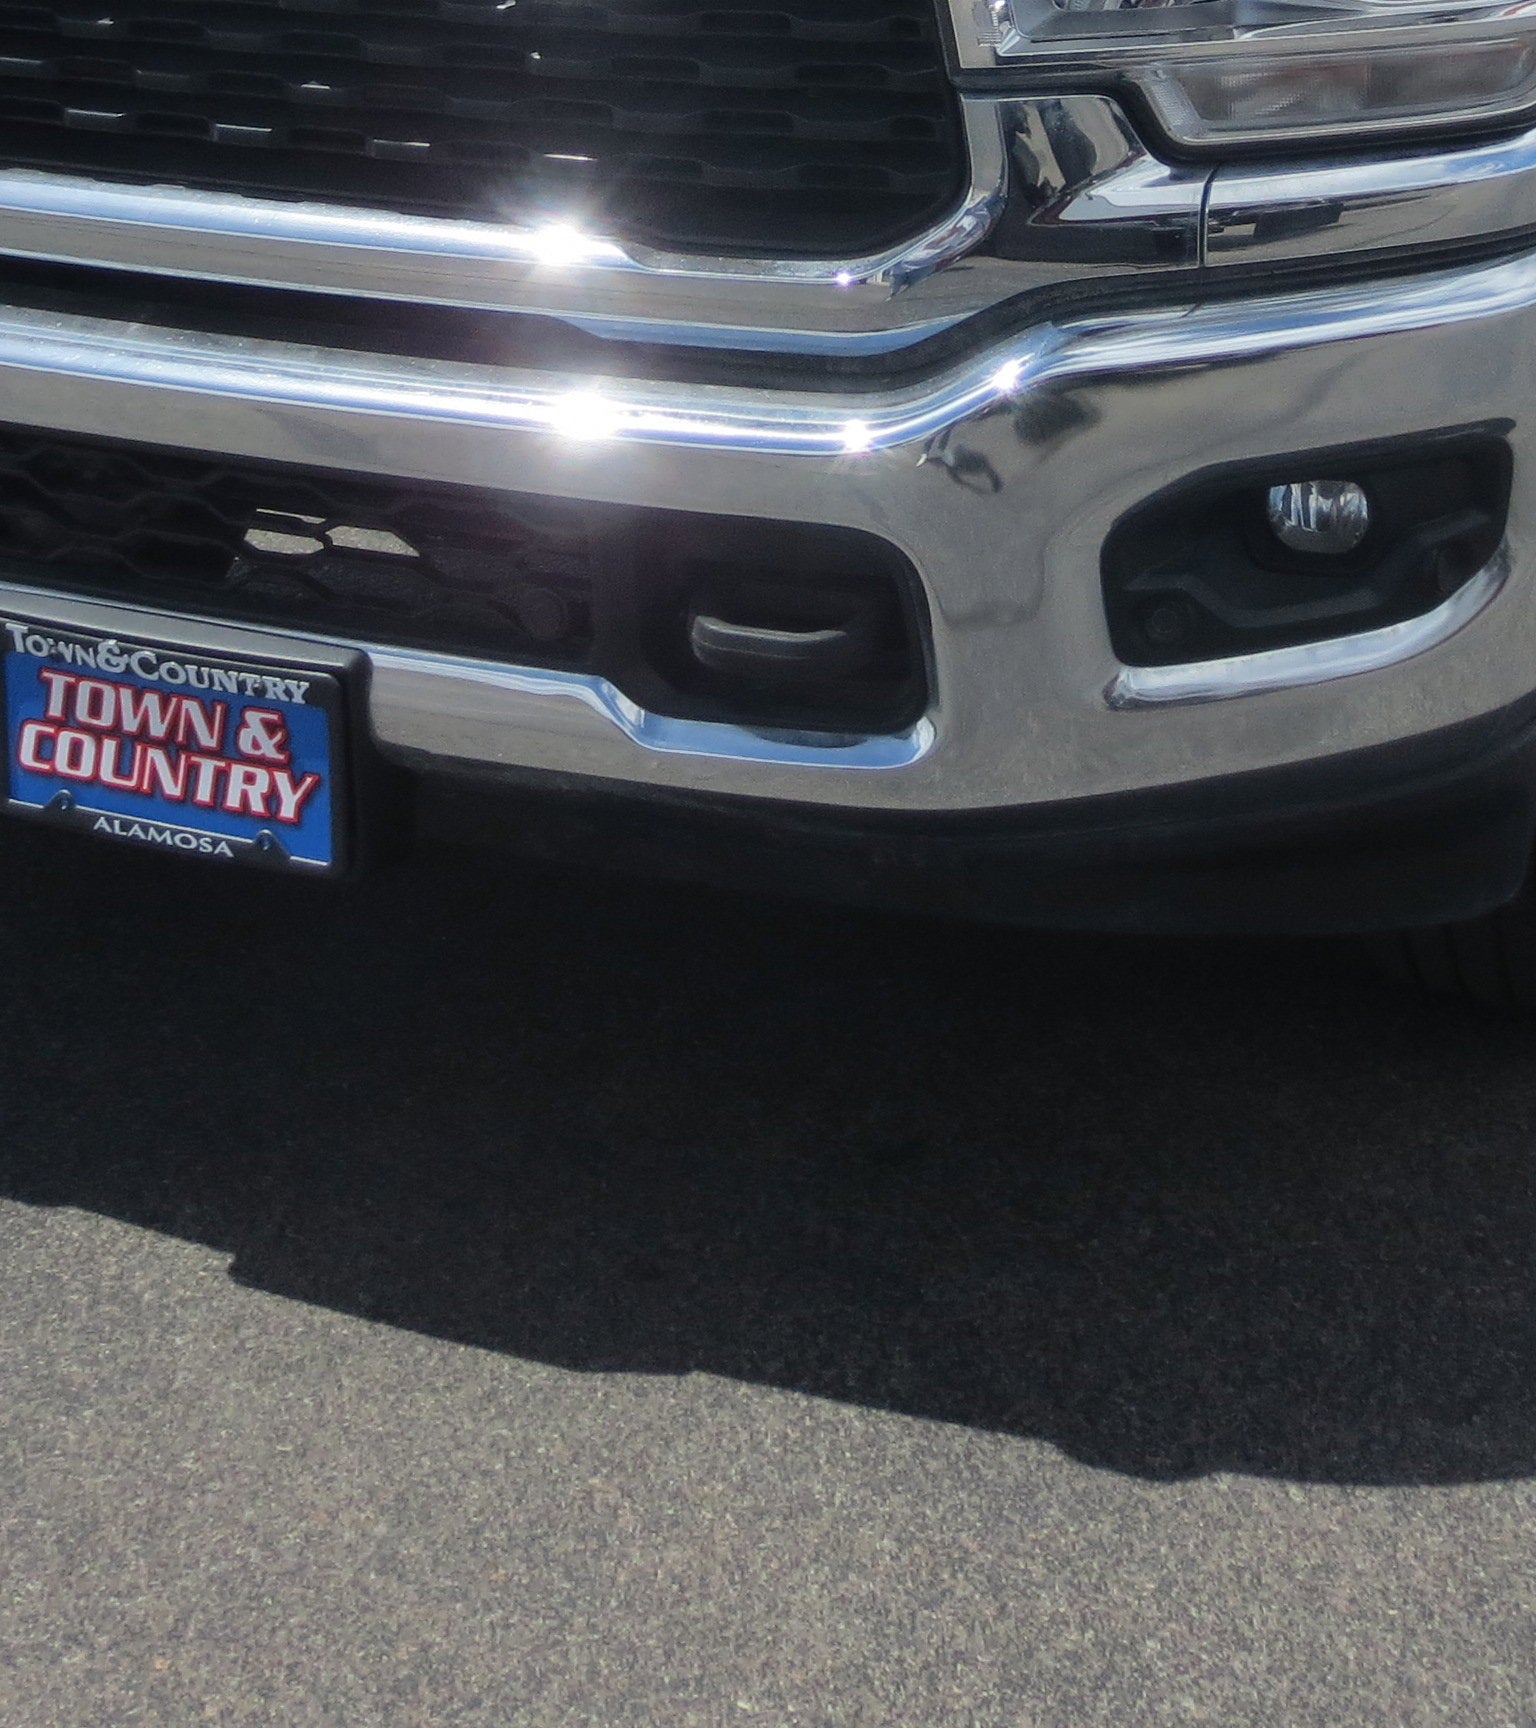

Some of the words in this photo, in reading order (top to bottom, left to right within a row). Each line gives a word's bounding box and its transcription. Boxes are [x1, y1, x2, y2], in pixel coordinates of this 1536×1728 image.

[40, 667, 226, 752] TOWN
[236, 707, 290, 763] &
[17, 719, 320, 824] COUNTRY
[92, 816, 234, 858] ALAMOSA
